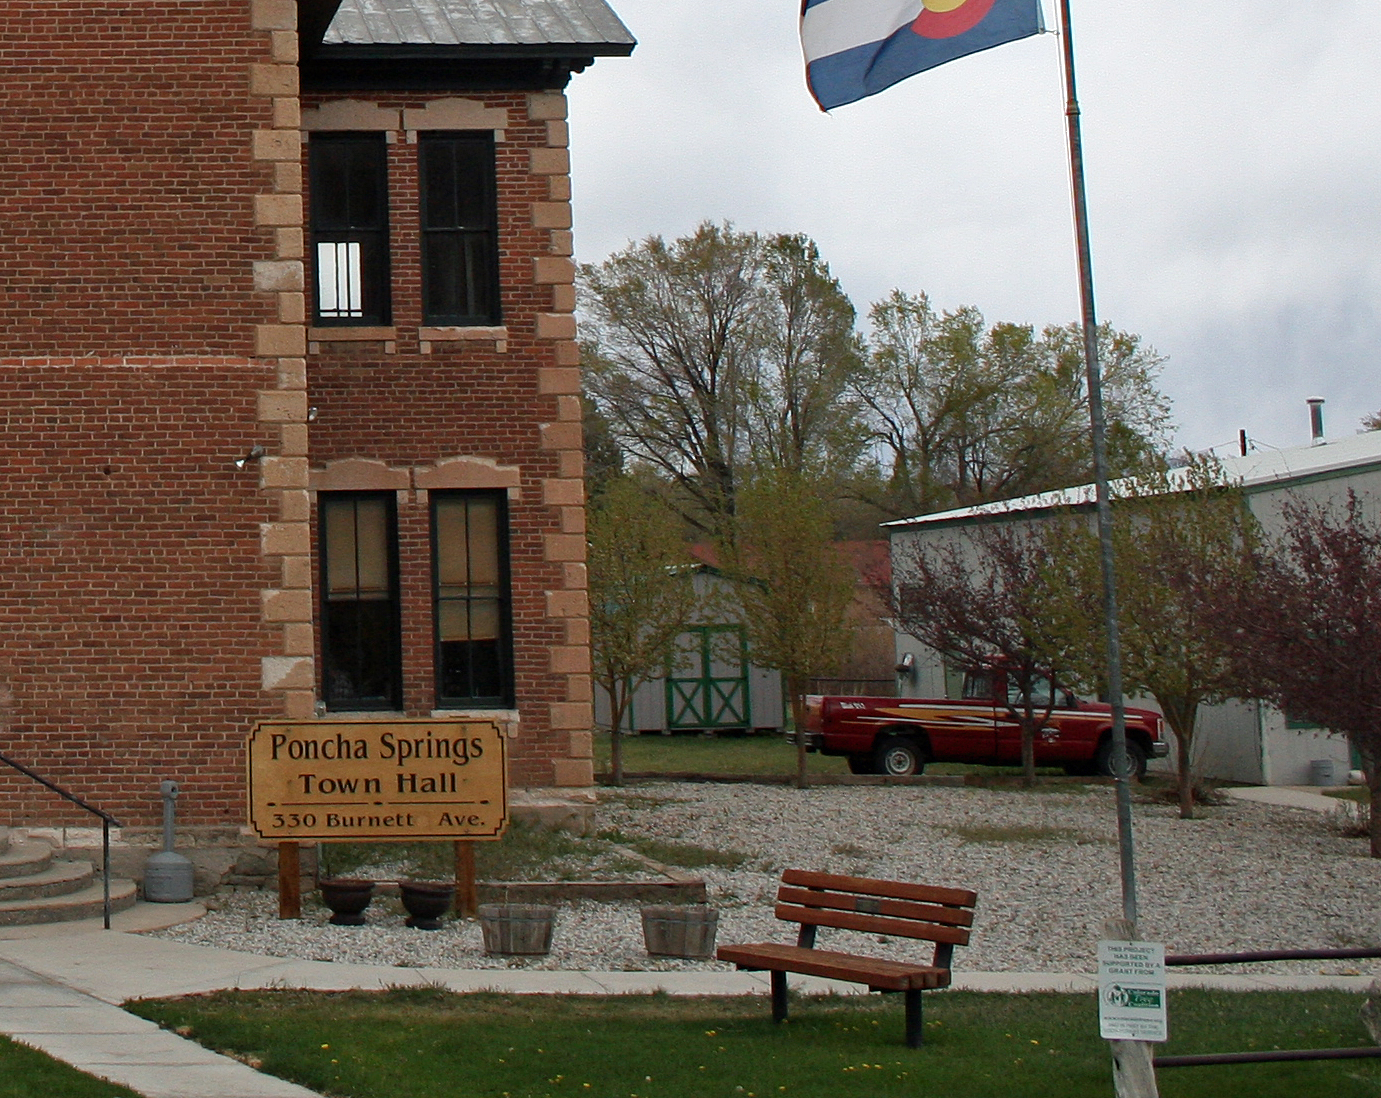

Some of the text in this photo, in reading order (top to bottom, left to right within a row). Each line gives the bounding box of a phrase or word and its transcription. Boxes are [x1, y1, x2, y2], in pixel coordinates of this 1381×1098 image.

[271, 731, 483, 766] Poncha Springs
[298, 772, 457, 794] Town Hall
[272, 812, 485, 828] 330 Burnett Ave.
